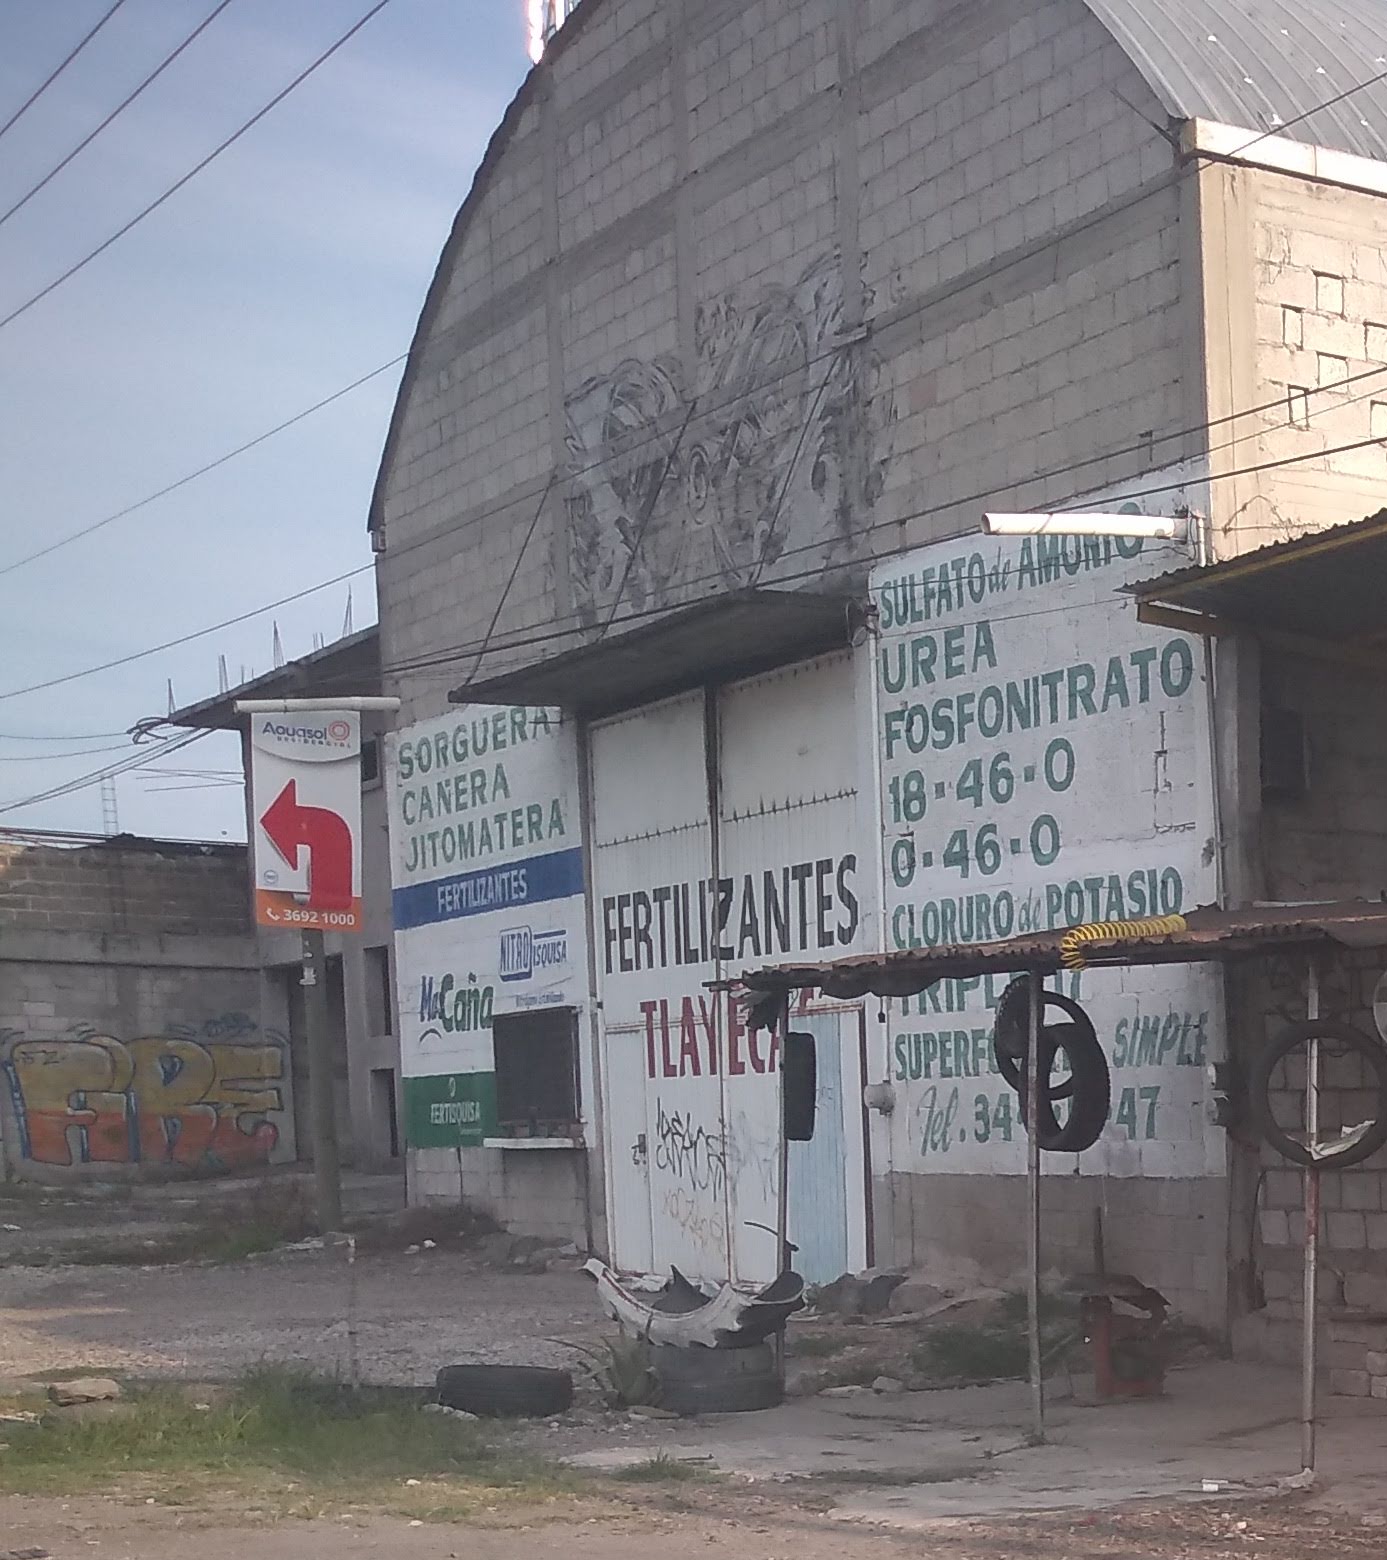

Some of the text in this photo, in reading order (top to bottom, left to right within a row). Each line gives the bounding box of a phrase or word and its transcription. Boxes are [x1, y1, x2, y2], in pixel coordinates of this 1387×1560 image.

[880, 552, 985, 630] SULFATO
[882, 620, 997, 694] UREA
[884, 637, 1193, 761] FOSFONITRATO
[399, 706, 551, 779] SORGUERA
[405, 798, 565, 872] JITOMATERA
[283, 908, 355, 926] 3692 1000
[437, 868, 528, 914] FERTILIZANTES
[602, 854, 859, 975] FERTILIZANTES
[892, 889, 1014, 950] CLORURO
[1045, 866, 1184, 921] POTASIO
[1113, 1010, 1208, 1067] SIMPLE
